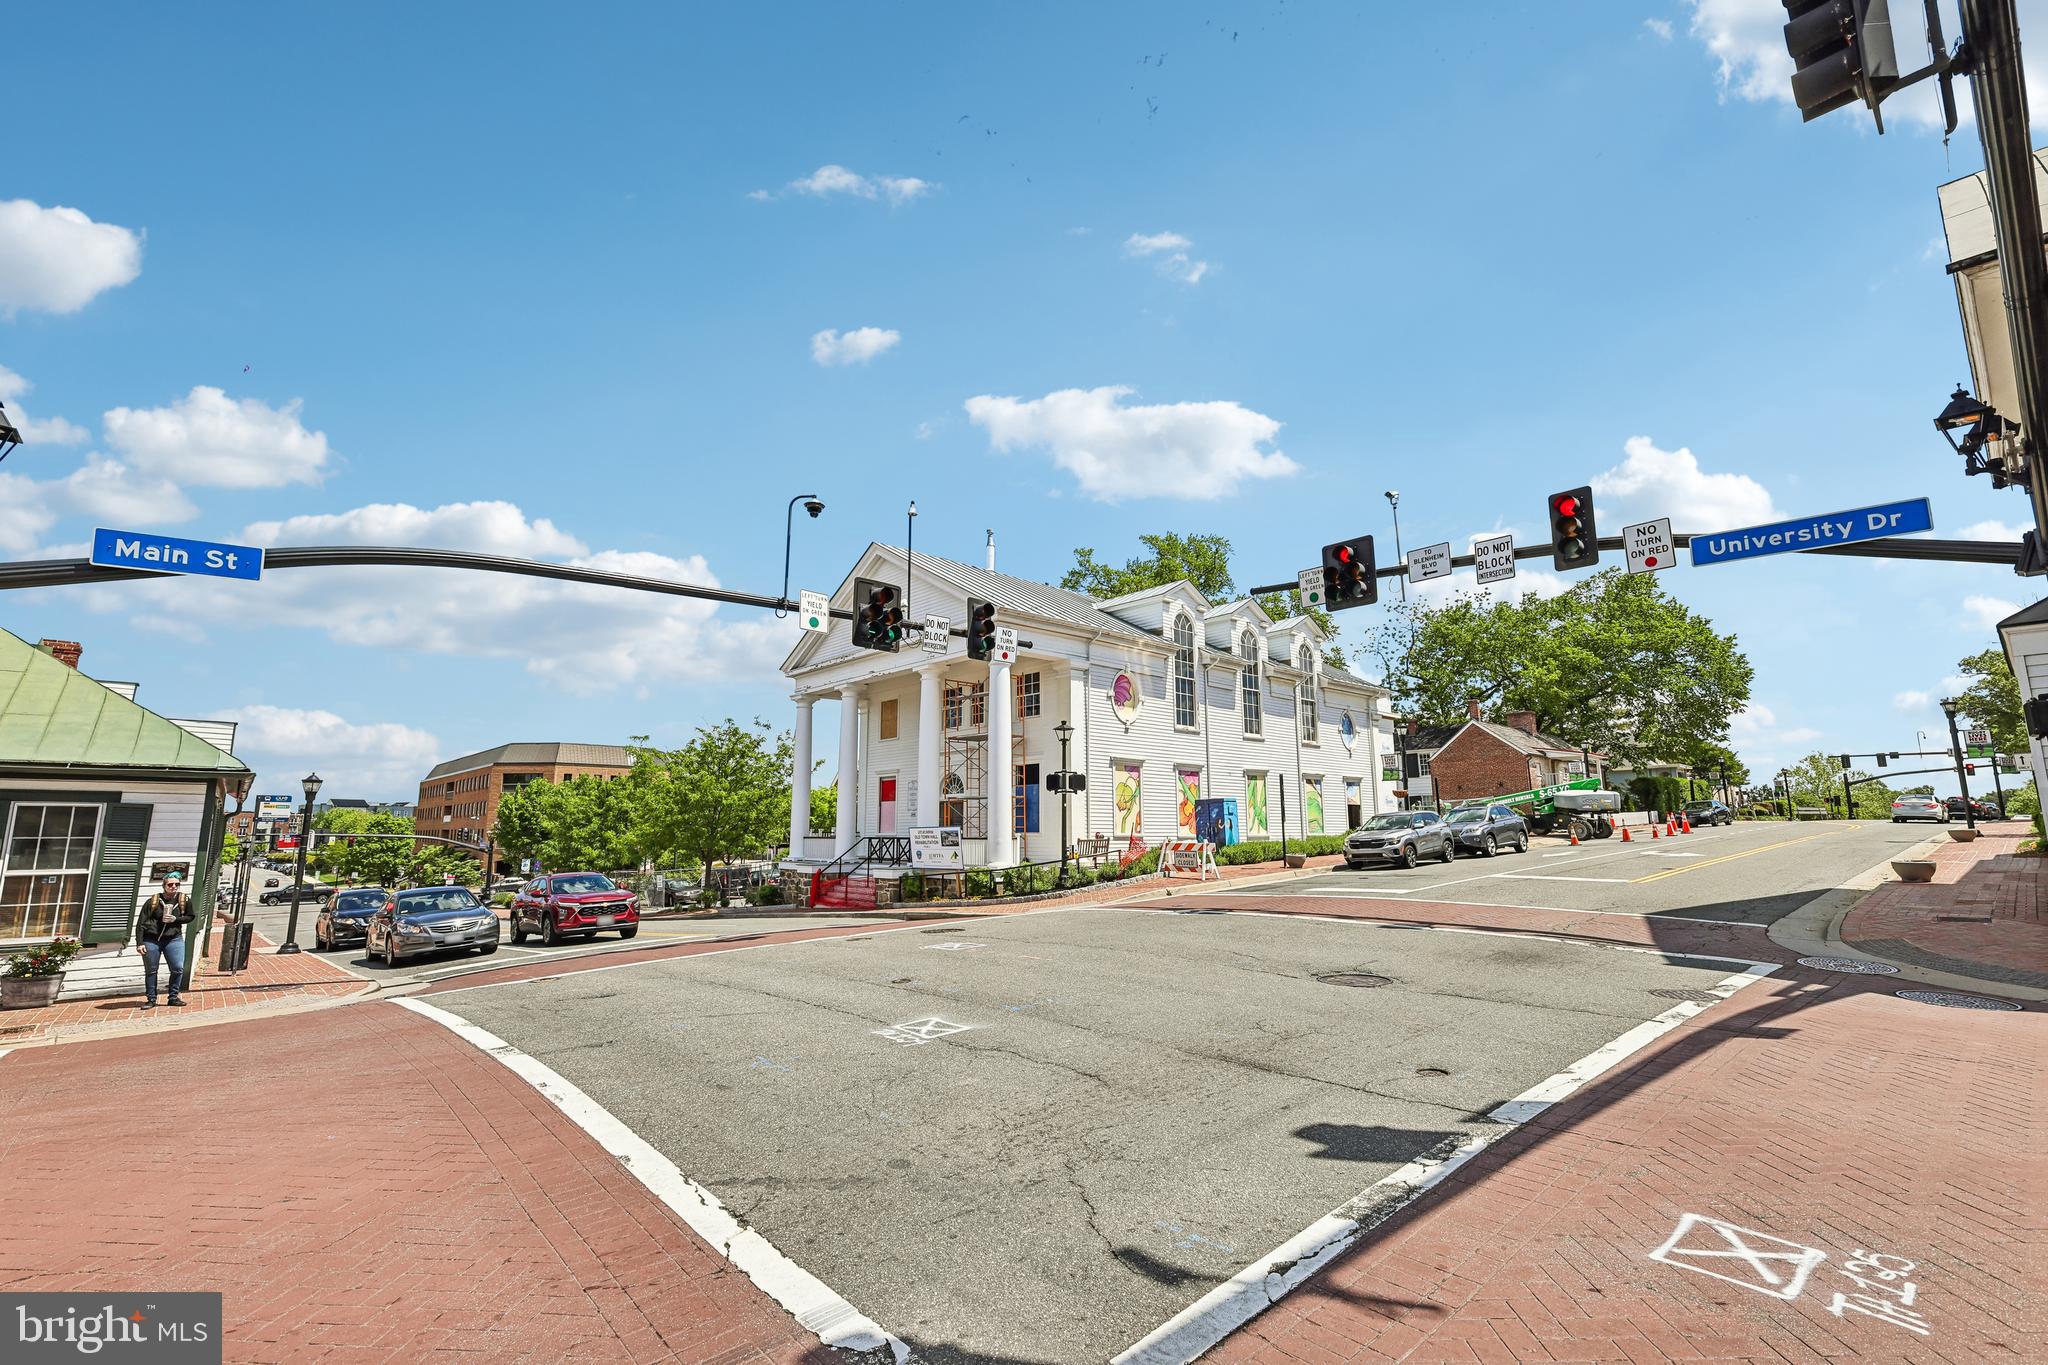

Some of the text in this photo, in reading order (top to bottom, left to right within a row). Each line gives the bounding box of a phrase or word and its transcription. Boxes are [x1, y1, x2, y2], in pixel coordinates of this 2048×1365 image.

[1636, 525, 1657, 537] NO
[1709, 512, 1902, 556] University Dr
[1635, 536, 1662, 548] TURN
[115, 538, 238, 570] Main St
[1477, 541, 1511, 557] DO NOT
[1631, 544, 1669, 559] ON RED
[1413, 553, 1444, 565] BLENHEIM
[1478, 555, 1512, 571] BLOCK
[1421, 561, 1437, 570] BLVD
[1479, 567, 1513, 580] INTERSECTION
[1305, 576, 1320, 585] YIELD
[1310, 583, 1325, 591] GREEN
[807, 600, 823, 610] YIELD
[811, 609, 827, 617] GREEN
[926, 619, 949, 630] DO NOT
[925, 631, 947, 643] BLOCK
[1001, 629, 1012, 637] NO
[924, 641, 947, 651] INTERSECTION
[1000, 637, 1013, 645] TURN
[1539, 788, 1558, 799] S-65
